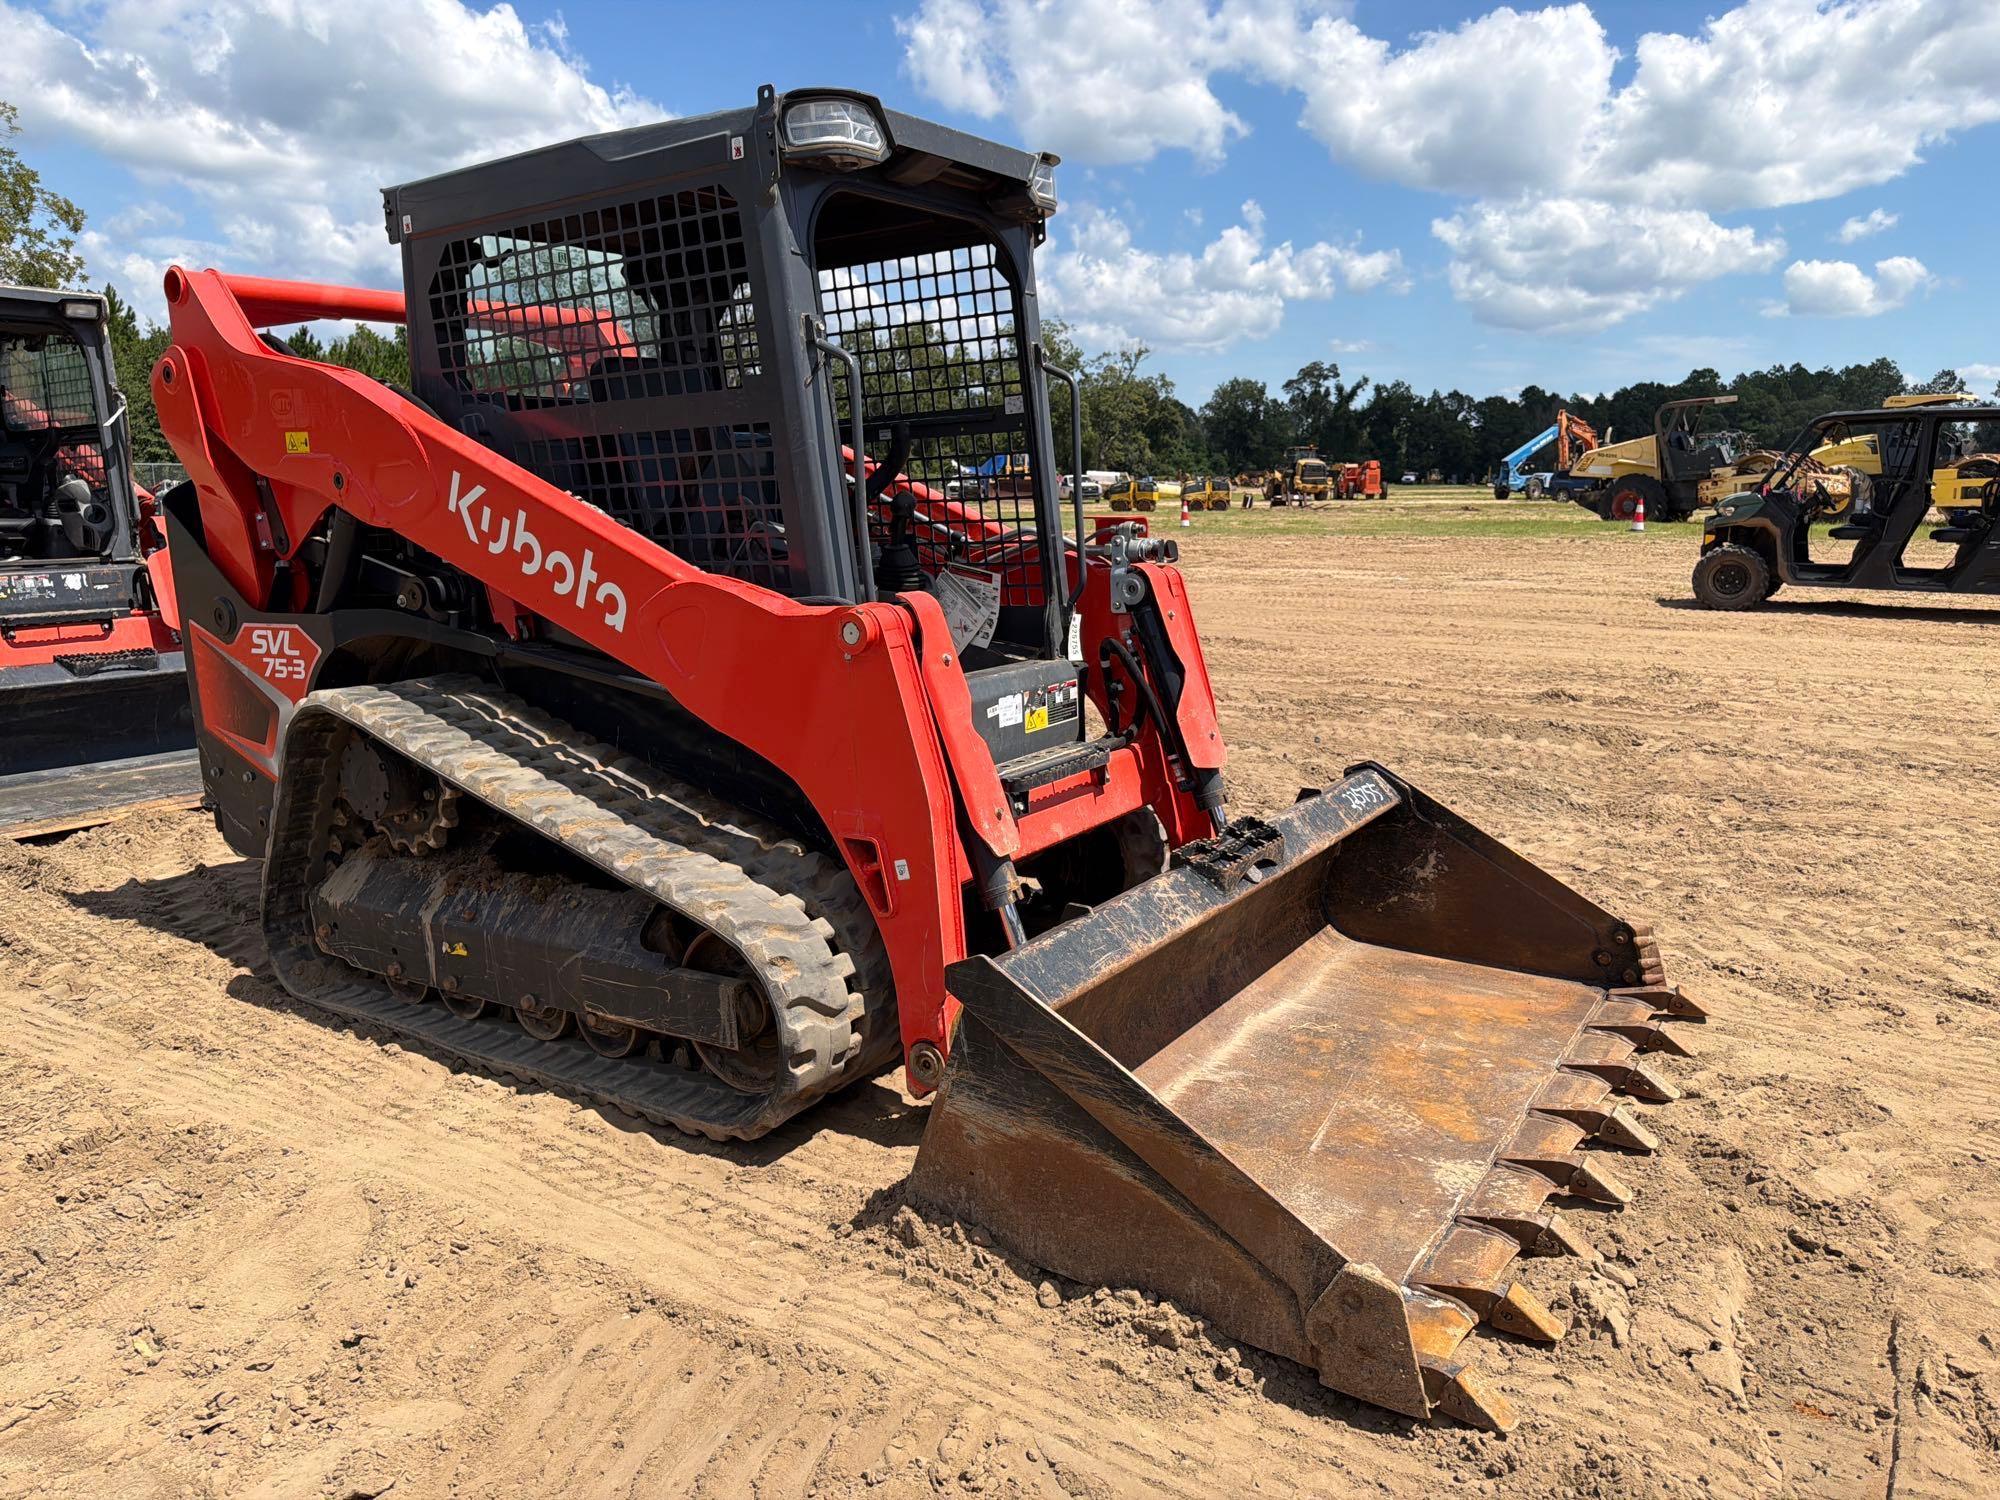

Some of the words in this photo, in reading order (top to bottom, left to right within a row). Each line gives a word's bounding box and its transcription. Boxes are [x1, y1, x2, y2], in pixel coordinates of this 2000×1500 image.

[448, 470, 627, 633] Kubota
[251, 629, 300, 656] SVL
[1072, 623, 1080, 655] 225755
[262, 657, 306, 680] 75-3
[1341, 782, 1384, 811] 225755
